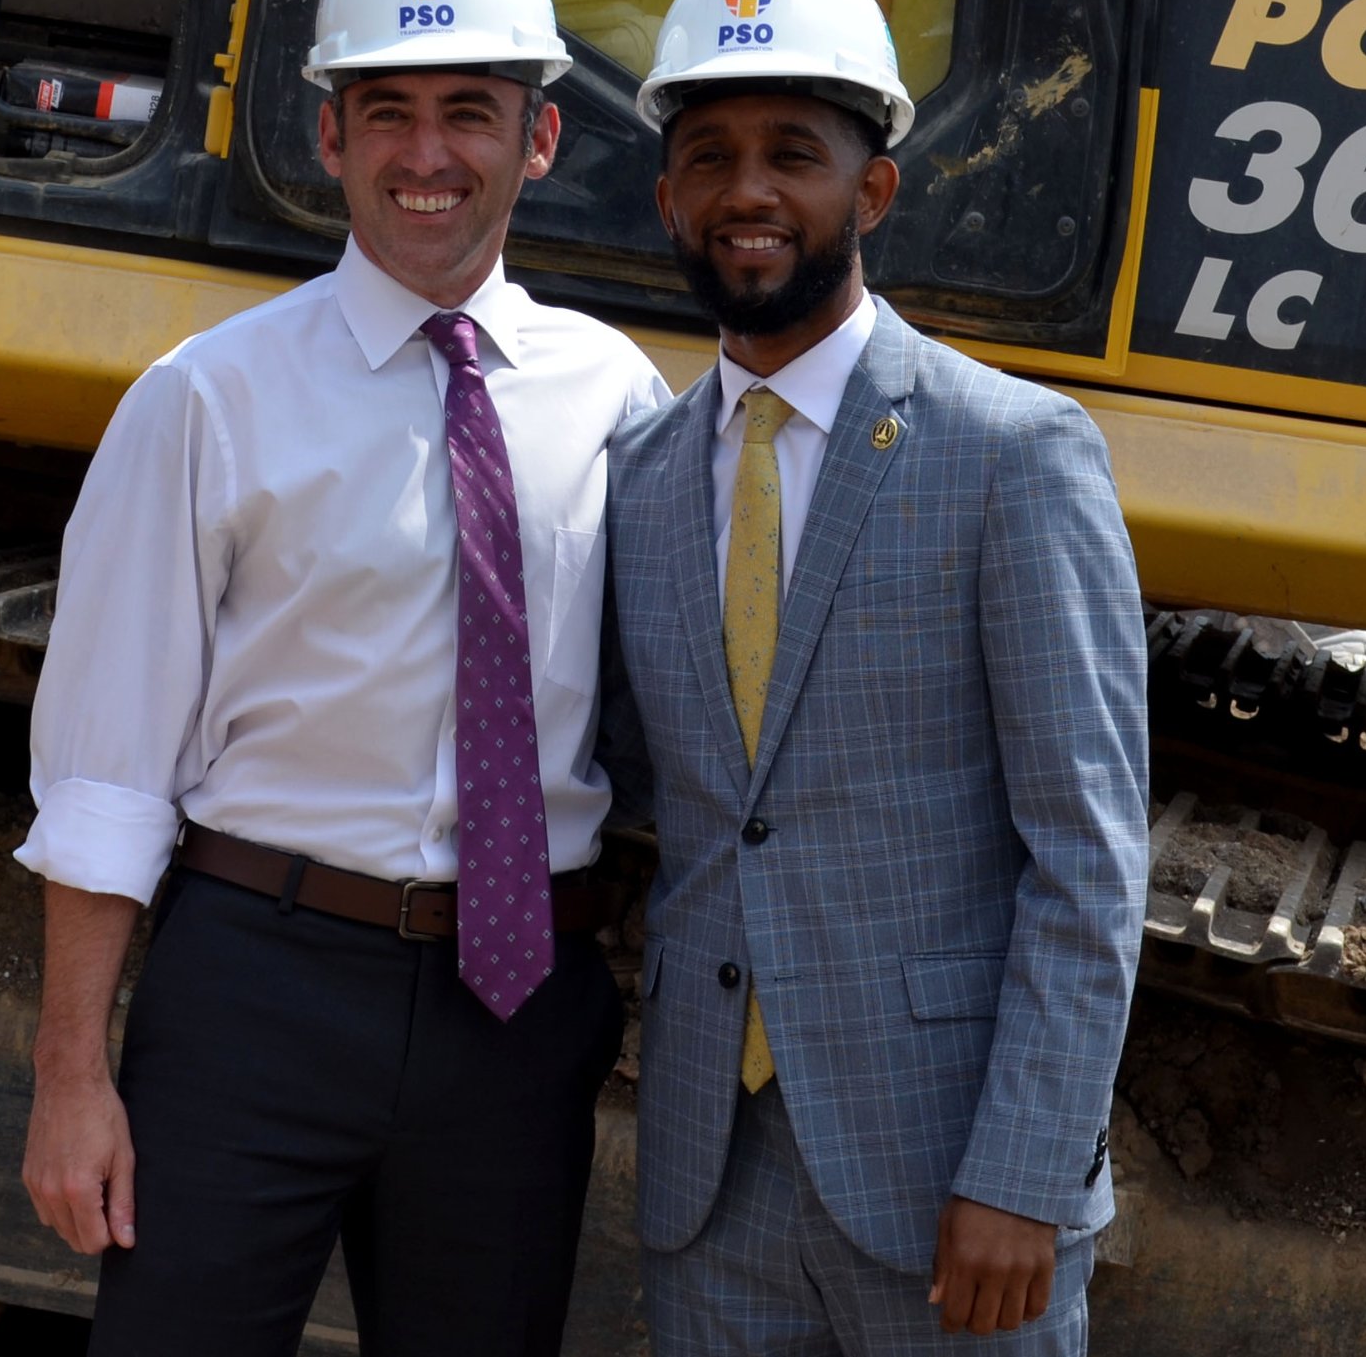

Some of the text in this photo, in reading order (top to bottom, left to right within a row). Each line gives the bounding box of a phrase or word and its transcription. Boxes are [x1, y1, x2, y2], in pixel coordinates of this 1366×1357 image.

[399, 4, 455, 28] PSO
[718, 23, 774, 46] PSO
[1174, 256, 1324, 350] LC
